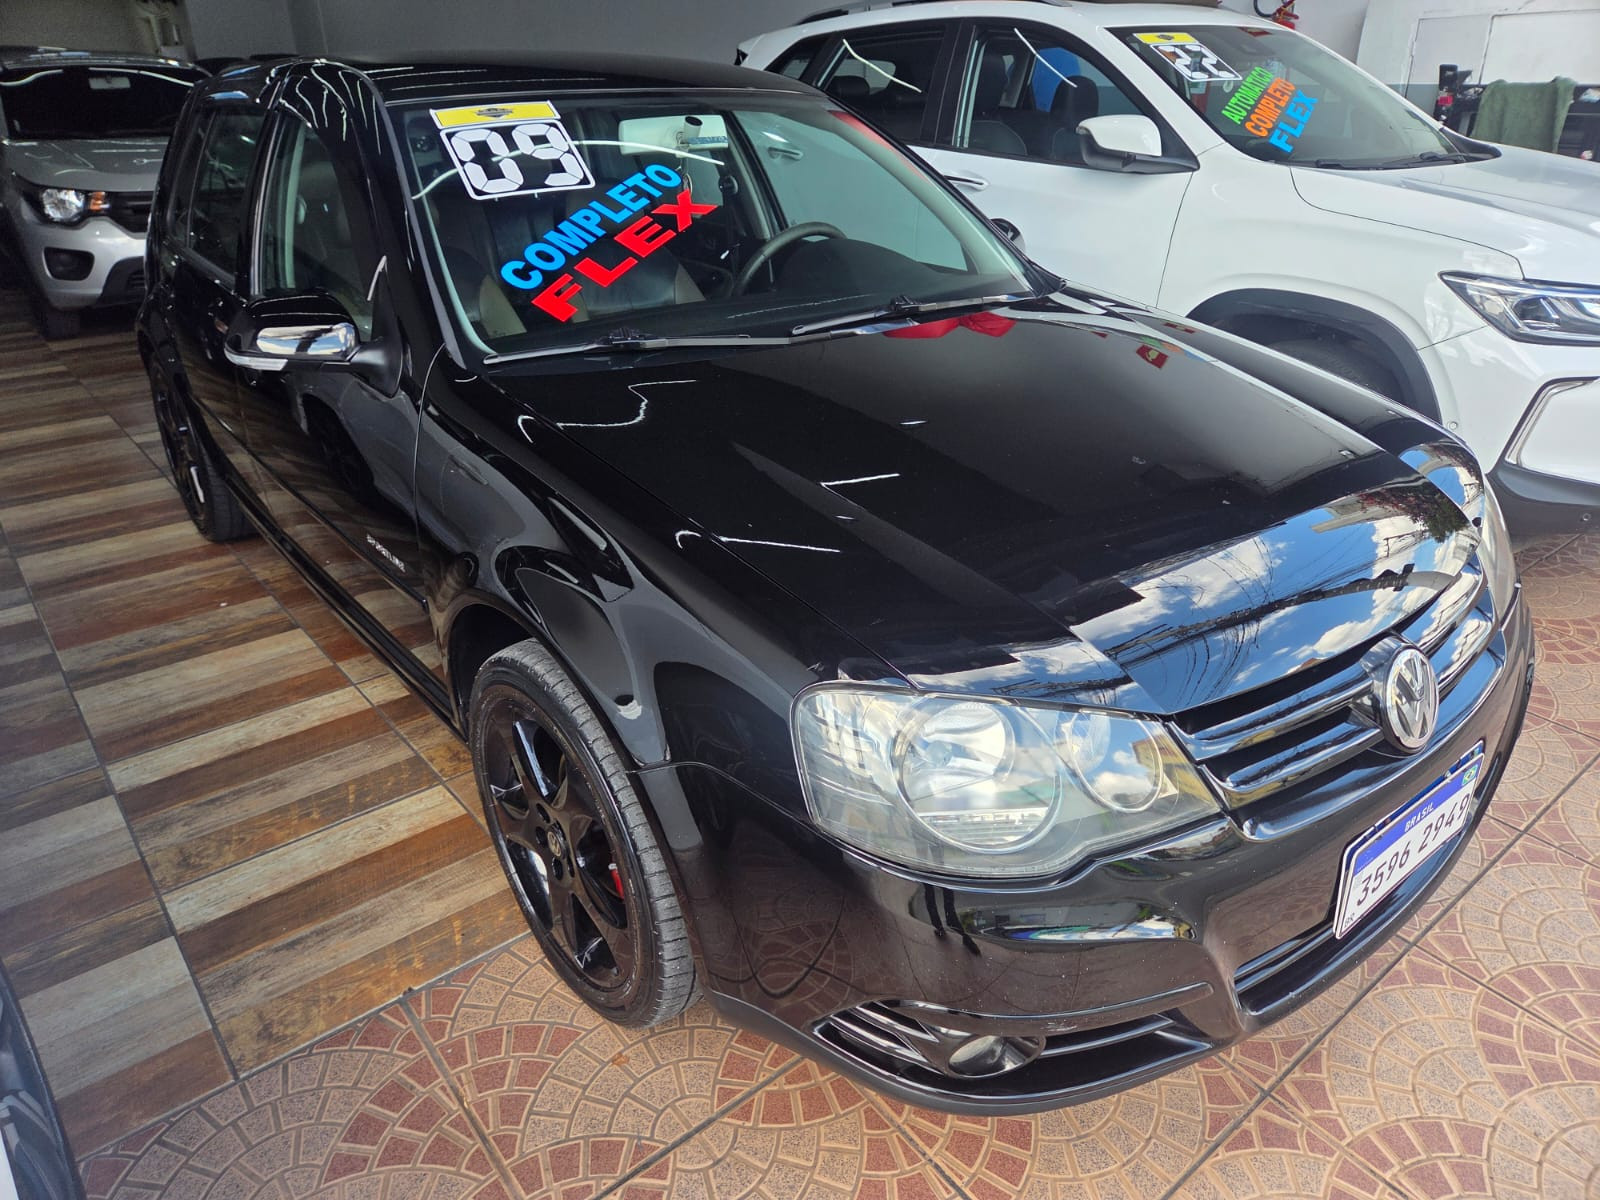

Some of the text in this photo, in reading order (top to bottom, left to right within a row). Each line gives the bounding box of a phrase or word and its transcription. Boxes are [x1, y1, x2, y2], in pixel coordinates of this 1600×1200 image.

[1157, 45, 1236, 80] 22
[1244, 77, 1296, 137] COMPLETO
[1268, 91, 1319, 153] FLEX
[450, 123, 584, 194] 09
[500, 163, 682, 290] COMPLETO
[531, 188, 719, 323] FLEX
[1356, 793, 1470, 906] 3596 2949
[1404, 802, 1434, 833] BRASIL
